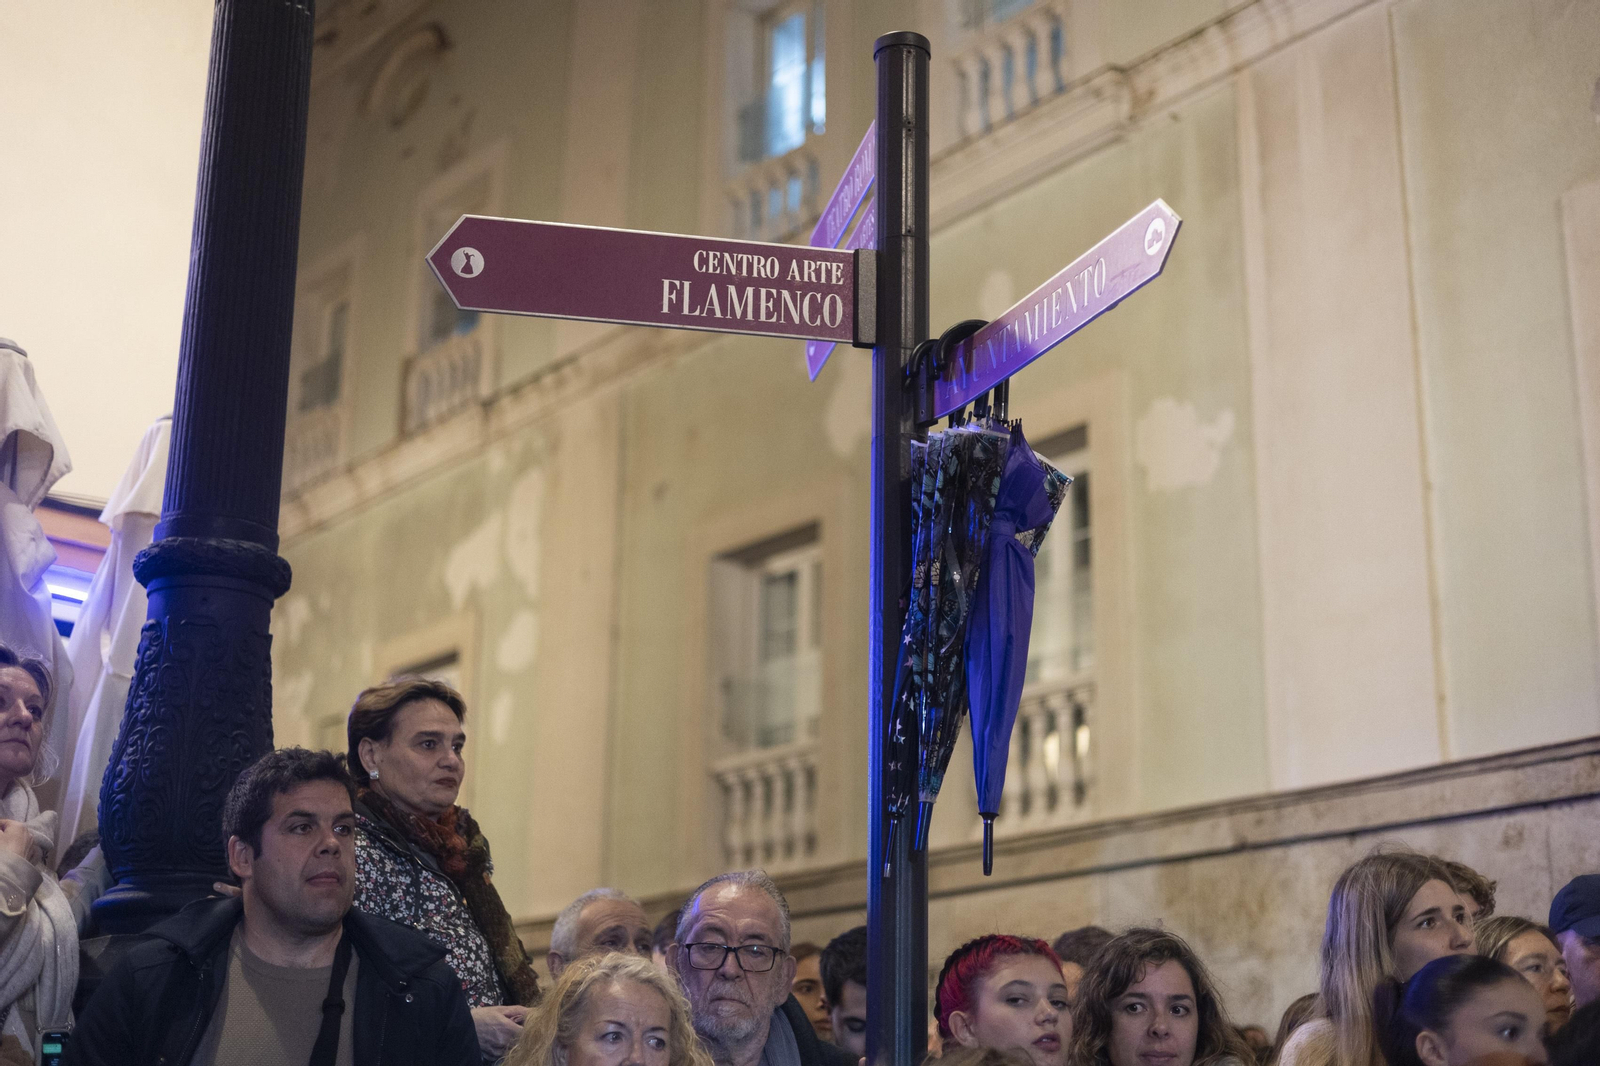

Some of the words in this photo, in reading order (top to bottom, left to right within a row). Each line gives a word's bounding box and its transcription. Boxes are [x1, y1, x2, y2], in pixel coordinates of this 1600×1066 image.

[693, 249, 780, 279] CENTRO
[786, 258, 845, 285] ARTE
[660, 278, 843, 329] FLAMENCO
[944, 257, 1107, 399] AYUNTAMIENTO
